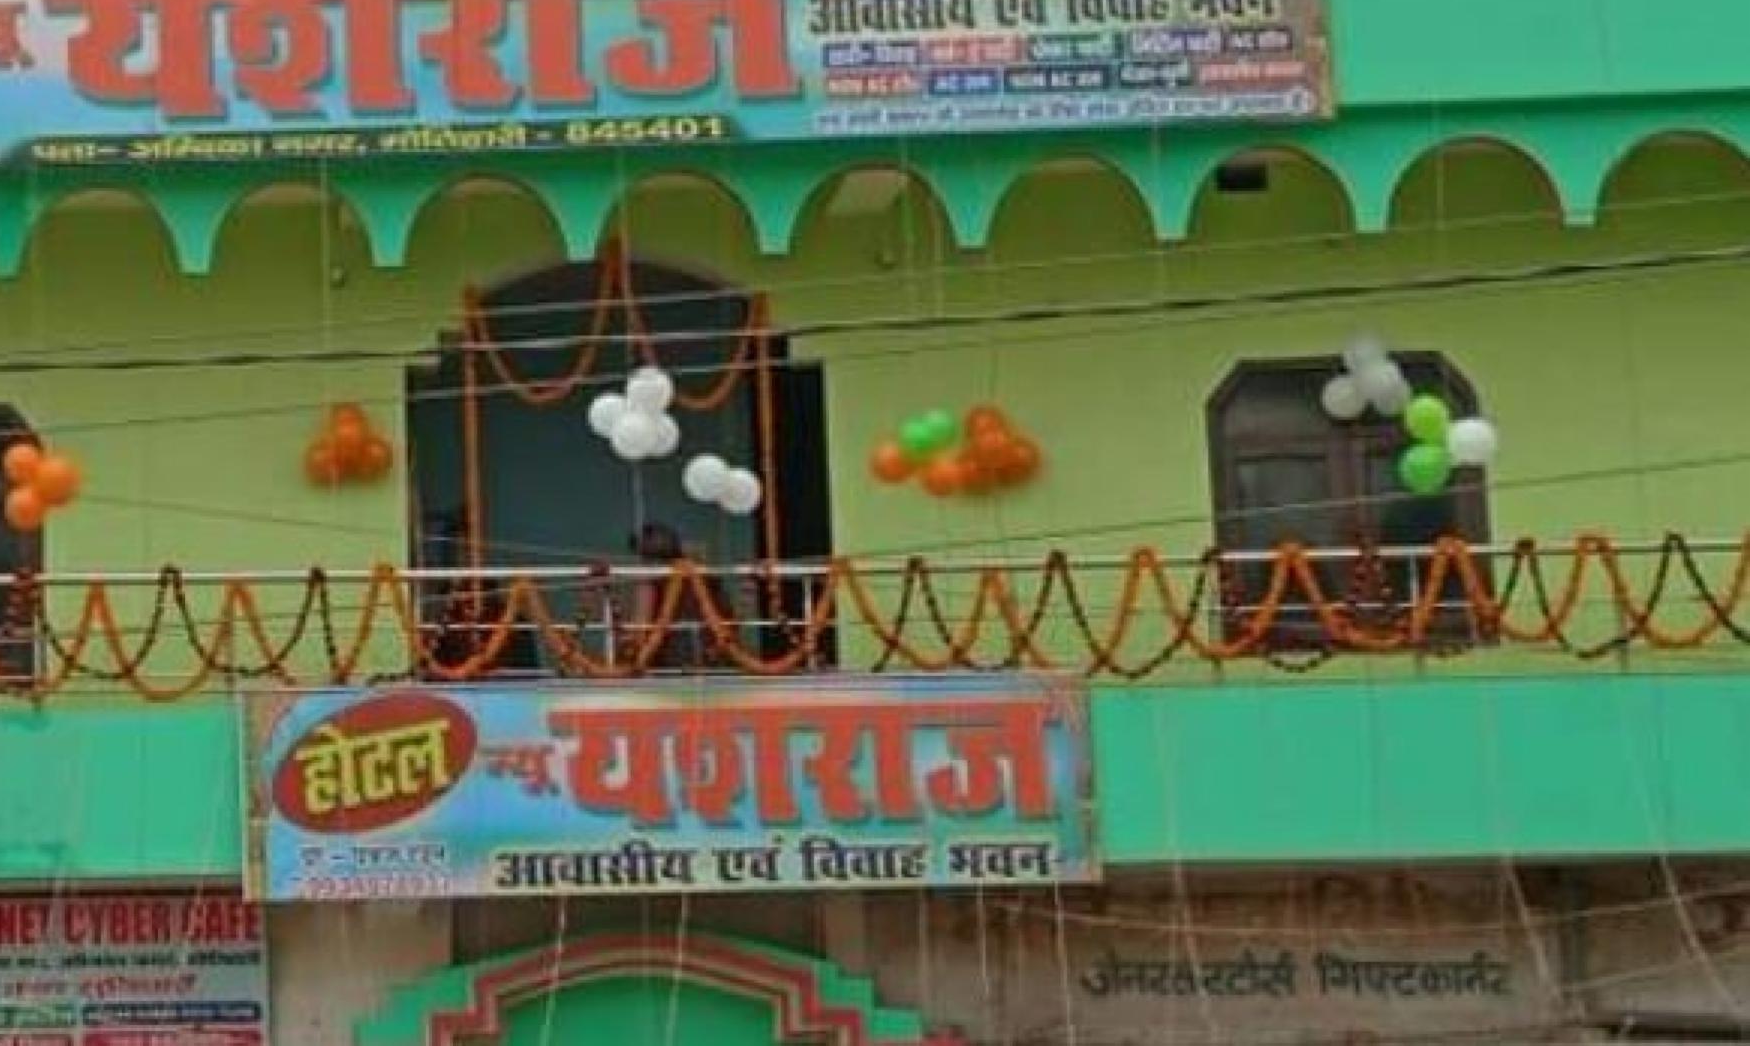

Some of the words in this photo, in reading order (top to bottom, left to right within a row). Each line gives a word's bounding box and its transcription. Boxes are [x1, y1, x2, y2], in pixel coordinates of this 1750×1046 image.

[565, 113, 722, 146] 845401
[296, 718, 450, 813] होटल
[549, 699, 1060, 828] यशराज
[494, 840, 693, 887] आवासीय
[711, 834, 782, 883] एवं
[802, 838, 929, 882] विवाह
[948, 842, 1053, 879] भवन
[63, 900, 172, 945] CYBER
